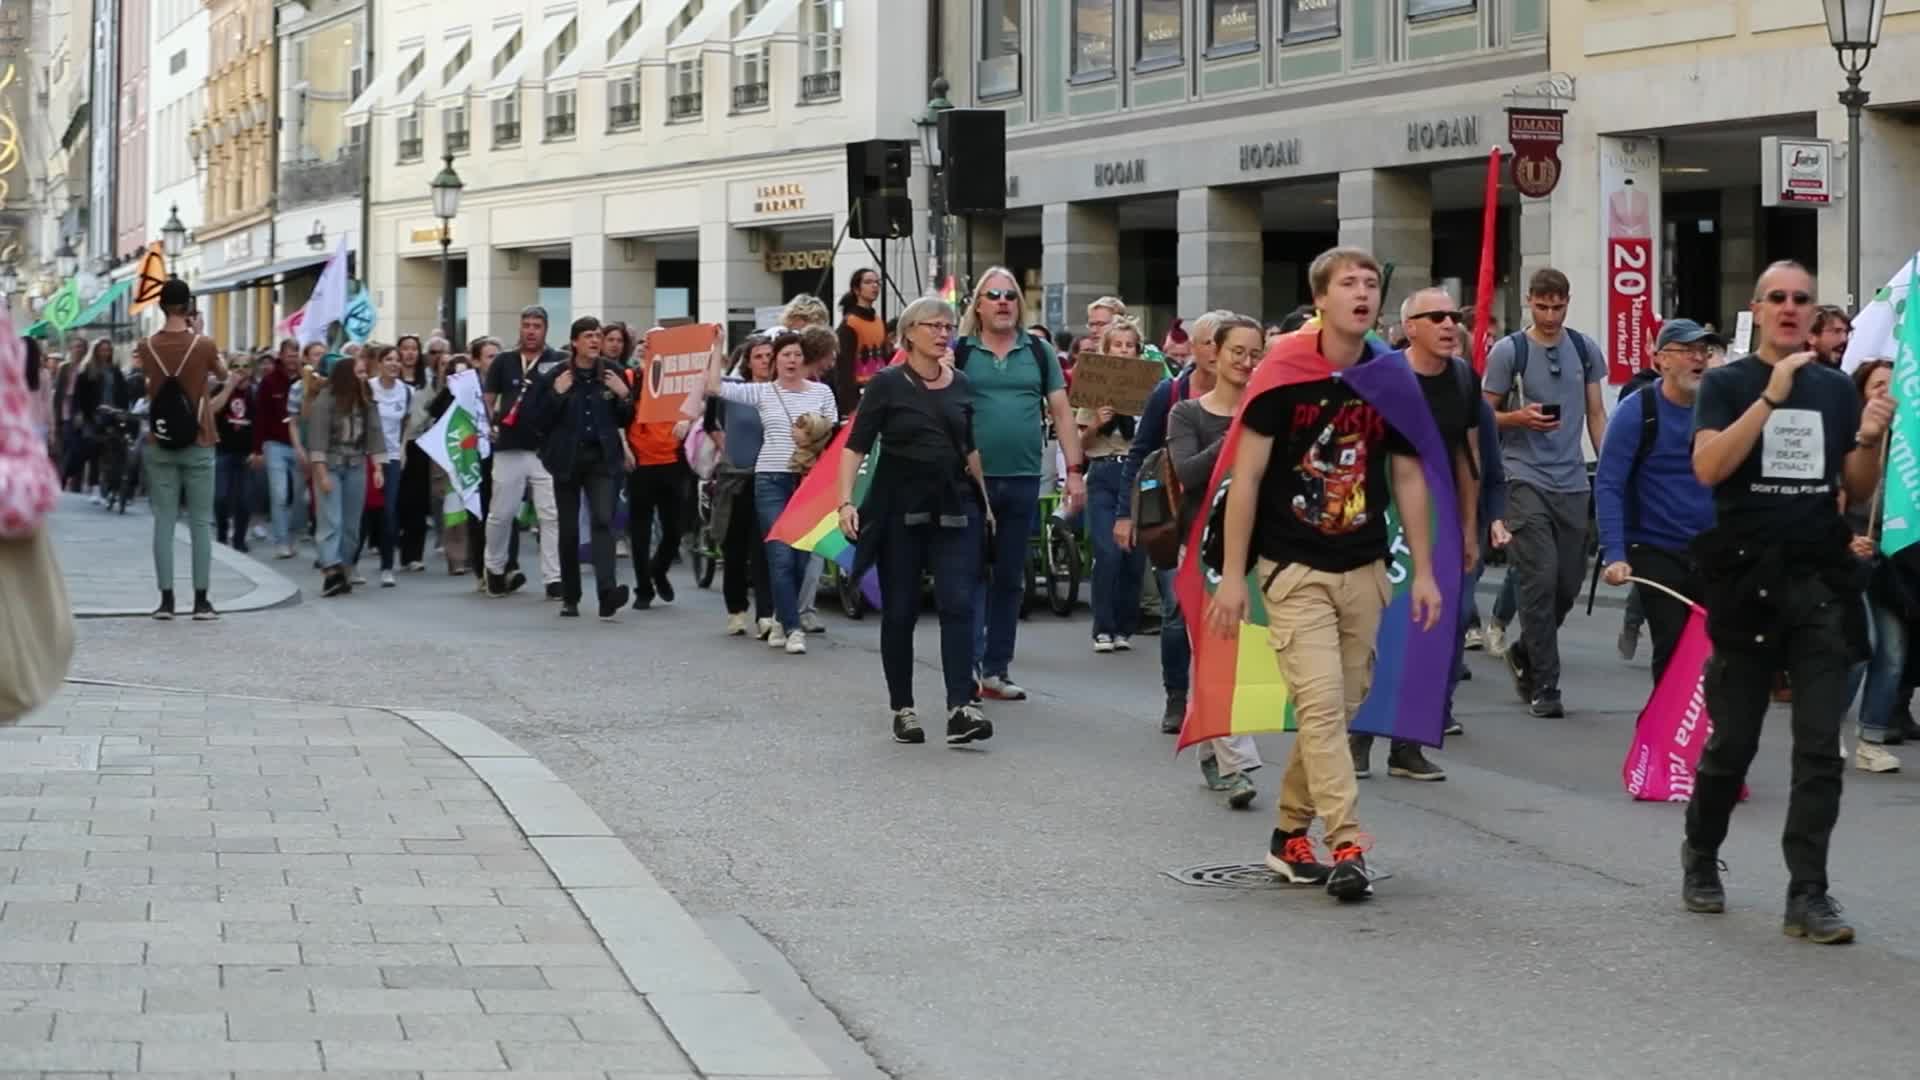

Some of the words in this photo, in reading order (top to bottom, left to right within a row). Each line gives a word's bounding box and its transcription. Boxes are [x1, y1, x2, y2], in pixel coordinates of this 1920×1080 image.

[1511, 119, 1560, 131] UMANI
[1407, 114, 1477, 152] HOGAN
[1239, 138, 1300, 171] HOGAN
[1095, 159, 1144, 187] HOGAN
[757, 183, 803, 198] ISABEL
[1617, 312, 1628, 366] verkauf
[1775, 426, 1812, 437] OPPOSE
[1783, 438, 1802, 449] THE
[1776, 450, 1809, 460] DEATH
[1770, 461, 1815, 473] PENALTY
